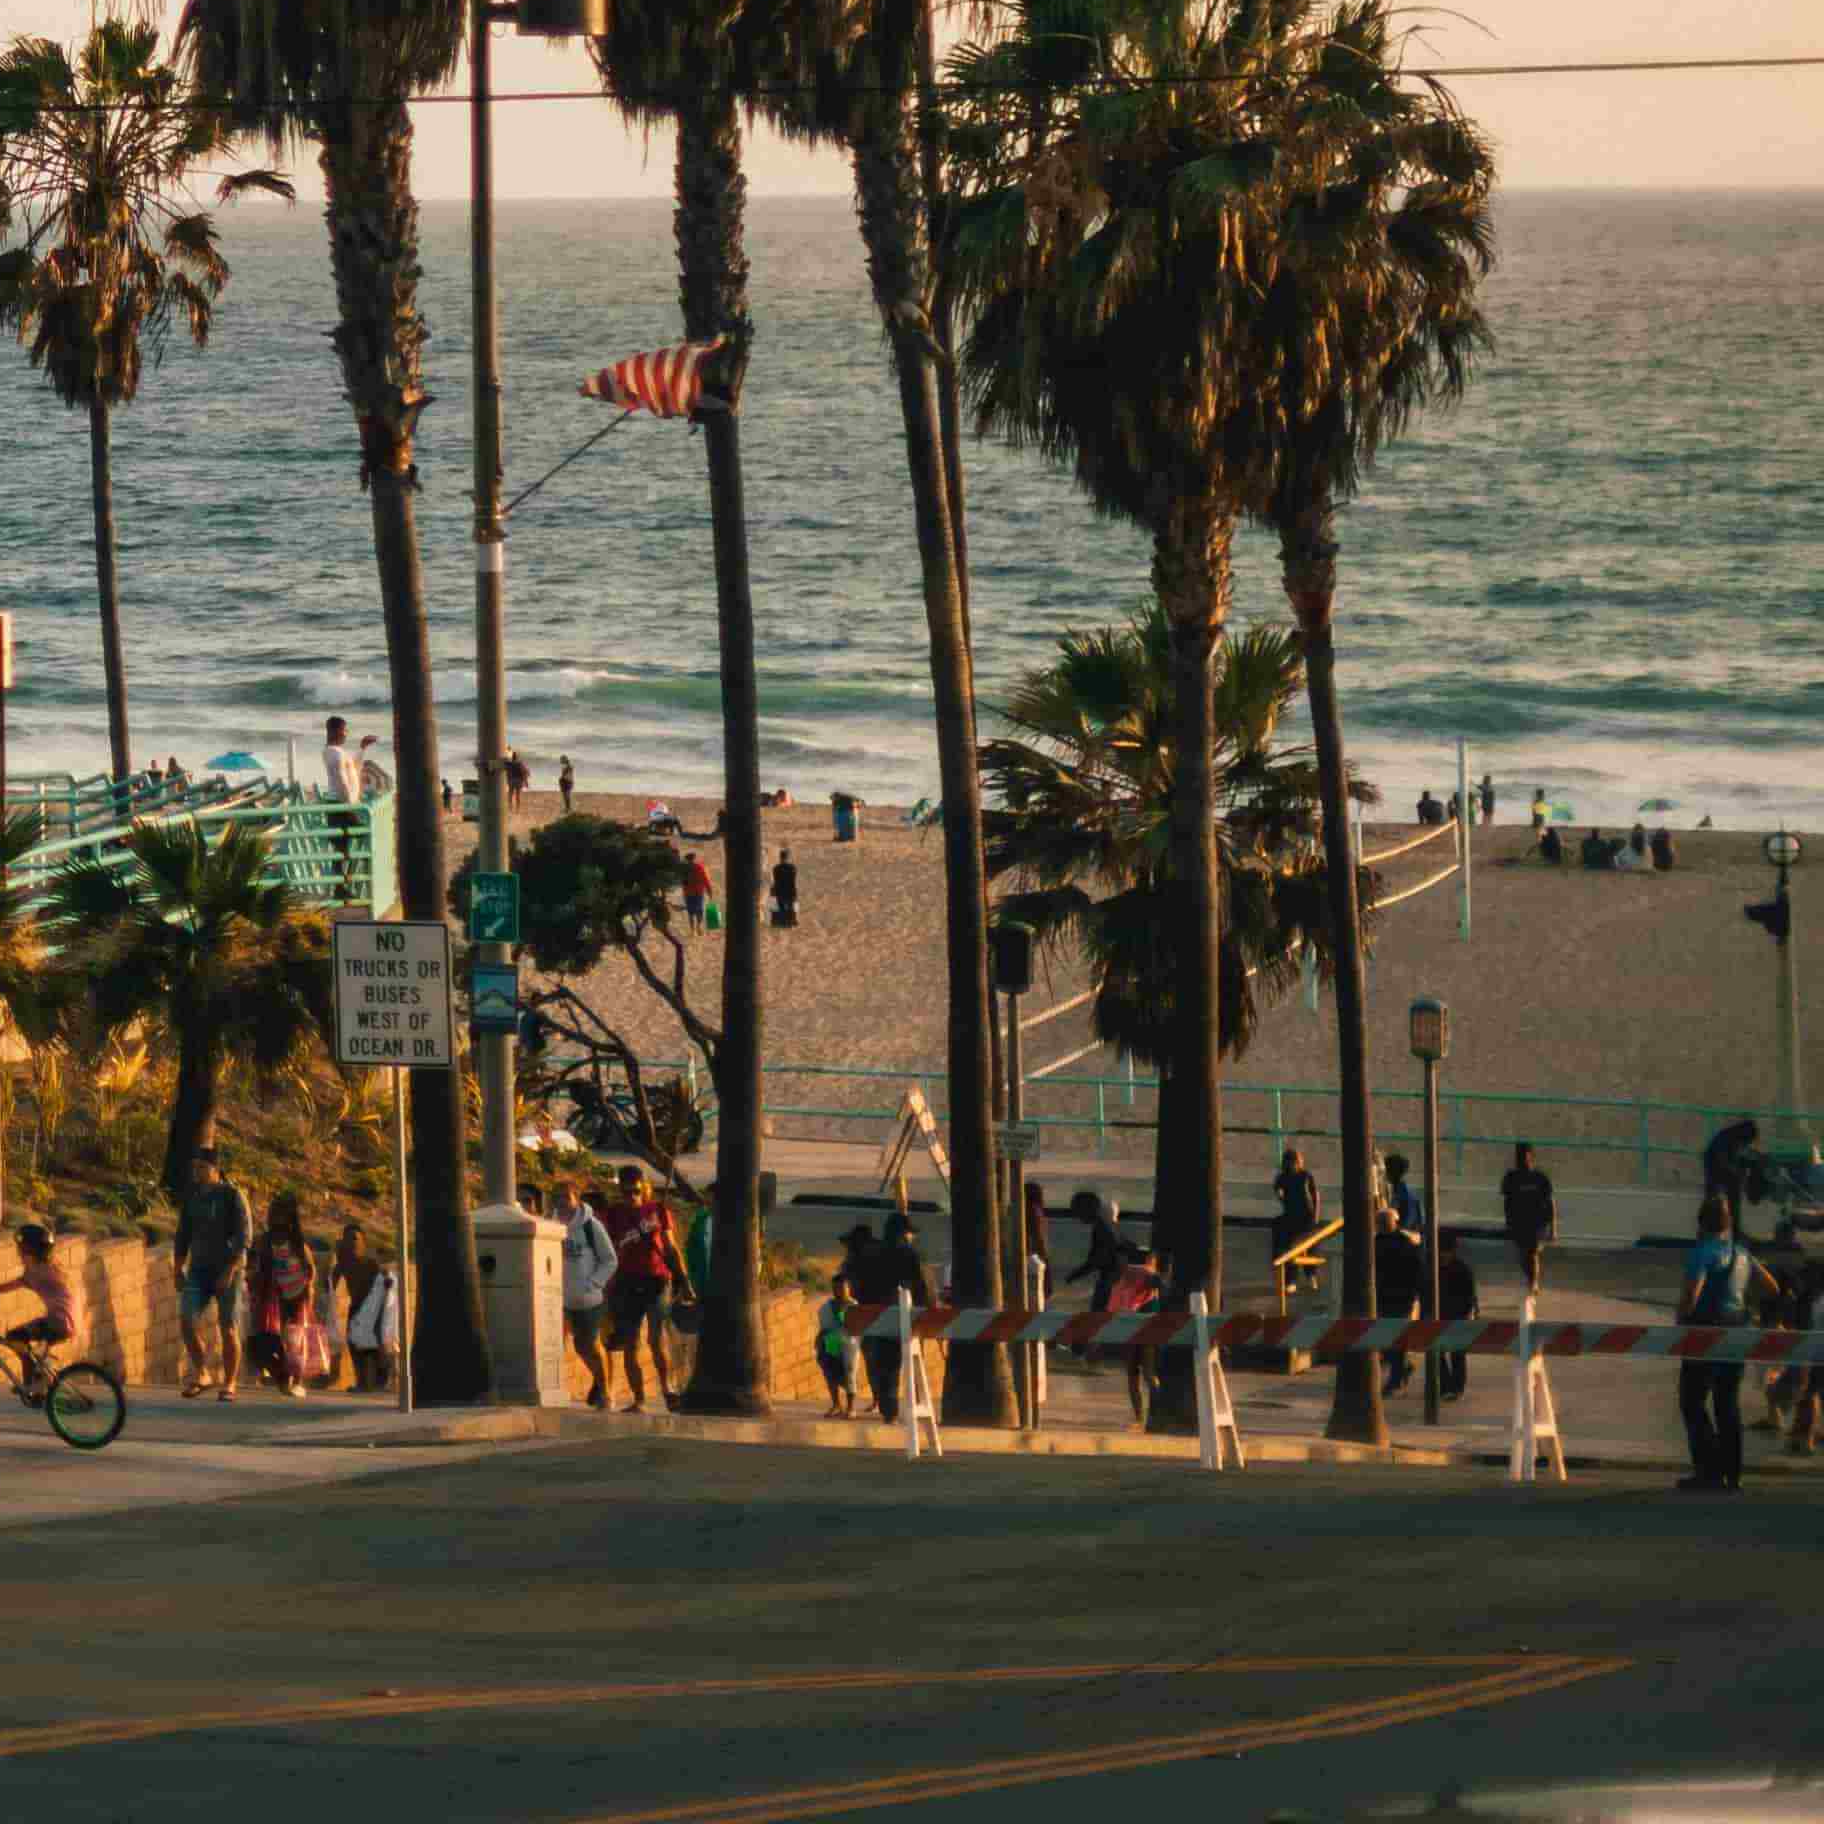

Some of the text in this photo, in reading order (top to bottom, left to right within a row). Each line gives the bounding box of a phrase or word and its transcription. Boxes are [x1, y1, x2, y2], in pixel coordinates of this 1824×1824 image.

[375, 931, 406, 953] NO
[343, 959, 441, 979] TRUCKS OR
[364, 984, 421, 1005] BUSES
[357, 1011, 431, 1031] WEST OF
[349, 1038, 440, 1057] OCEAN DR.
